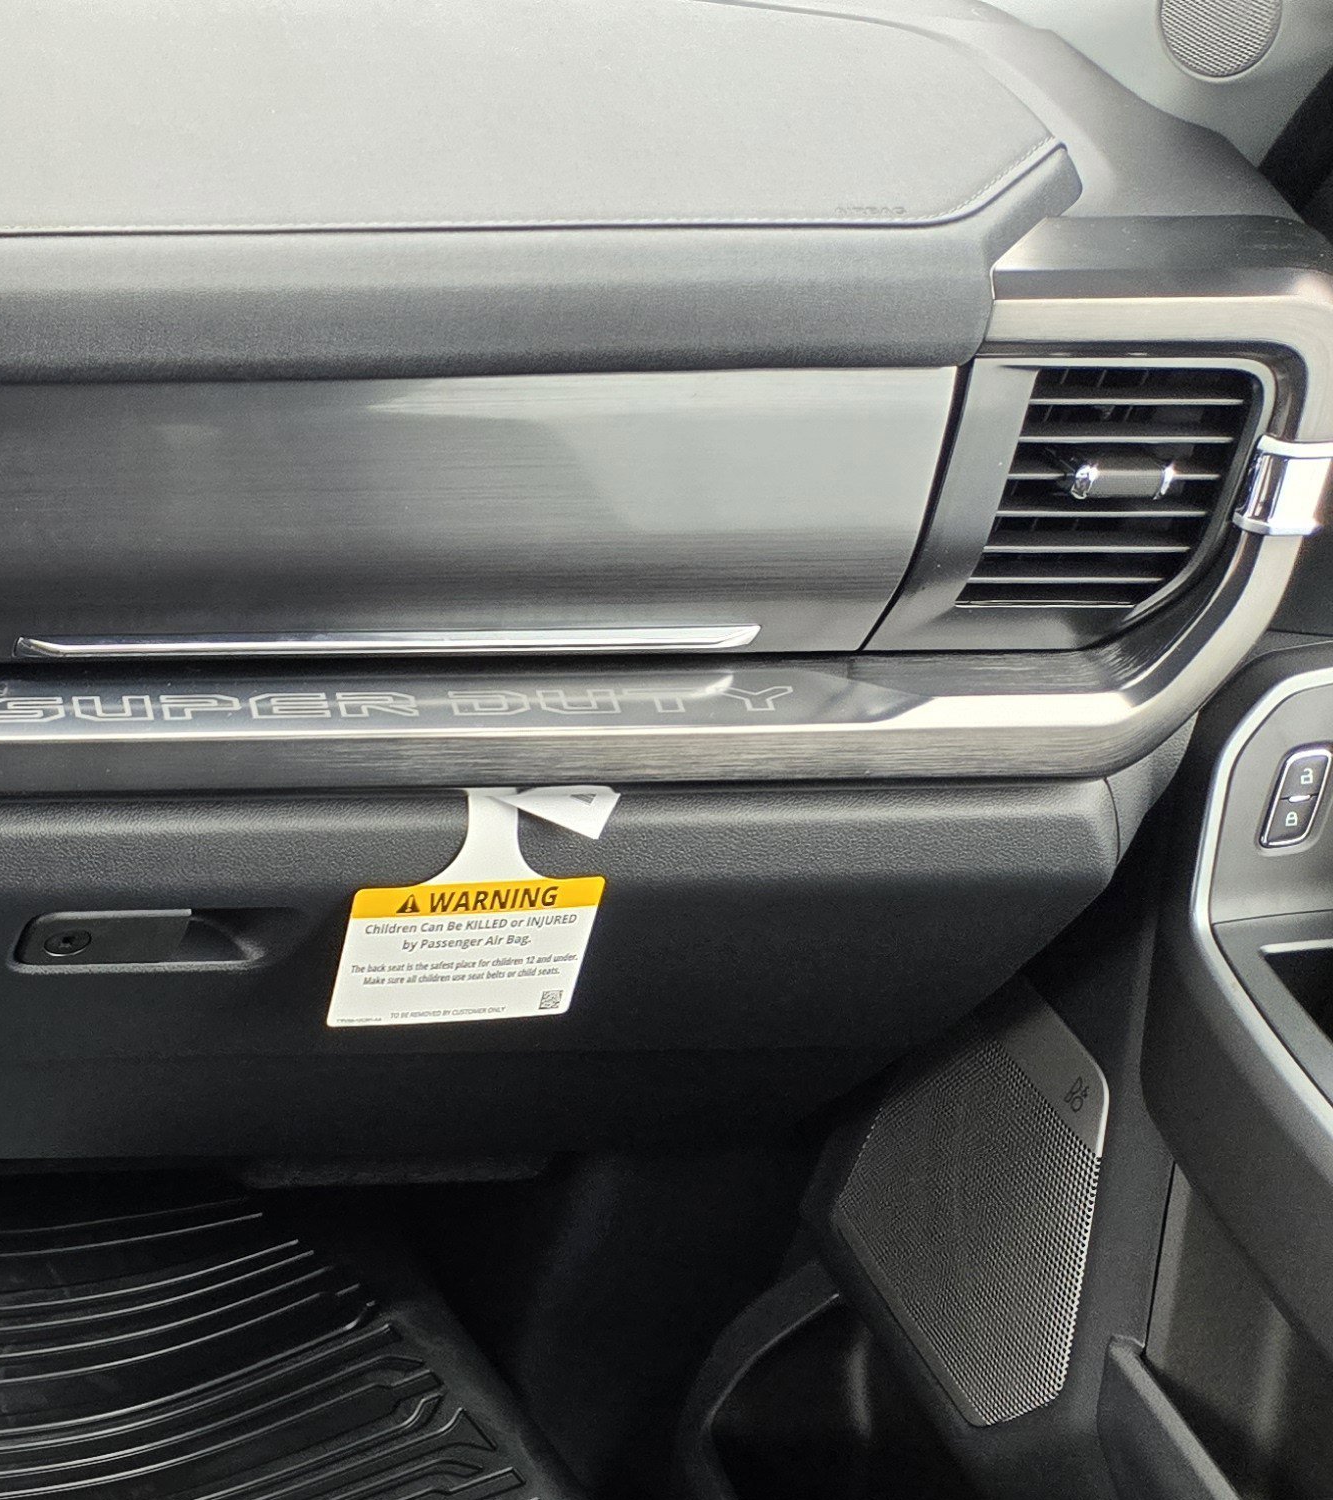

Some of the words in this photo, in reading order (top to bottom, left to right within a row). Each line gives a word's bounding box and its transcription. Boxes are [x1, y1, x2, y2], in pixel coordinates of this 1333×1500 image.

[446, 685, 794, 716] DUTY
[430, 886, 560, 913] WARNING
[365, 924, 417, 935] Children
[420, 922, 444, 933] Can
[447, 921, 463, 931] Be
[465, 919, 508, 930] KILLED
[510, 918, 525, 928] or
[526, 914, 578, 929] INJURED
[402, 940, 418, 952] by
[420, 937, 483, 950] Passenger
[484, 935, 504, 946] Air
[506, 934, 532, 946] Bag.
[351, 965, 365, 973] The
[367, 964, 386, 973] back
[387, 964, 405, 972] seat
[415, 962, 429, 971] the
[430, 961, 454, 970] safest
[455, 960, 477, 971] place
[478, 959, 491, 968] for
[491, 957, 524, 967] children
[526, 955, 536, 964] 12
[536, 954, 553, 963] and
[363, 976, 386, 985] Make
[406, 975, 418, 983] all
[418, 973, 451, 982] children
[467, 972, 484, 980] seat
[486, 970, 506, 979] belts
[517, 968, 537, 977] child
